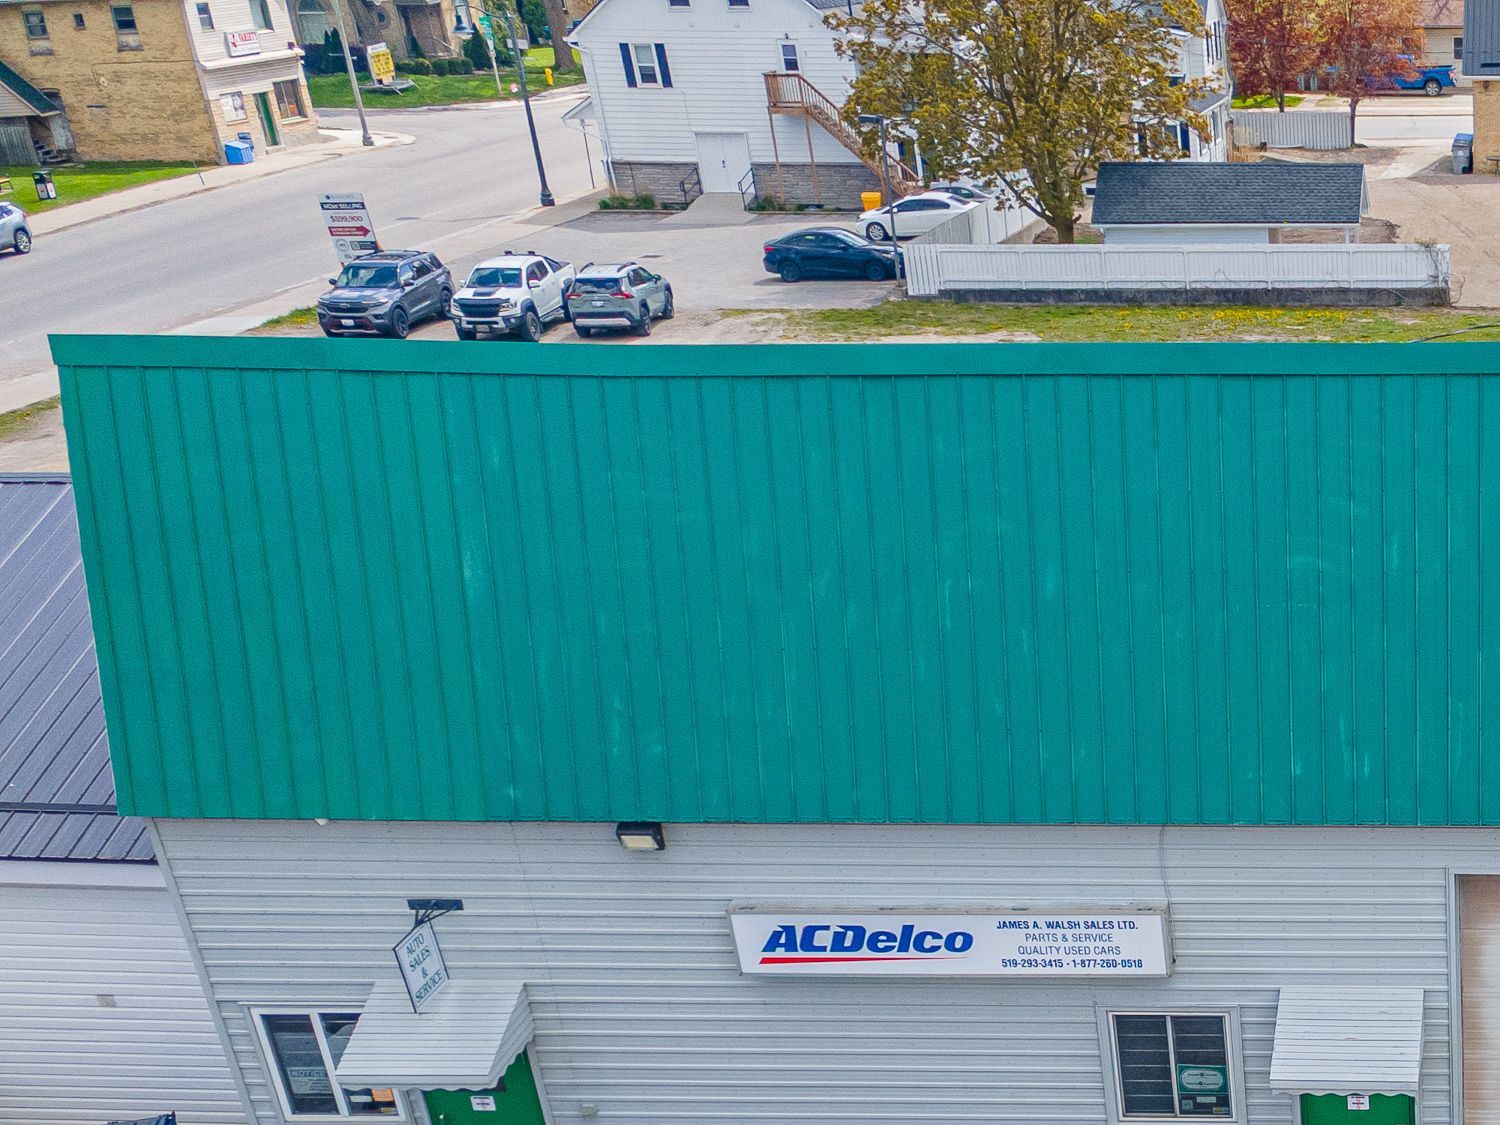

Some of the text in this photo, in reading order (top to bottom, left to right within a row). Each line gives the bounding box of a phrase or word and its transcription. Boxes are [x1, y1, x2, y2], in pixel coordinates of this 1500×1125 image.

[997, 920, 1139, 930] JAMES A. WALSH SALES LTD.
[761, 924, 974, 954] ACDelco
[1025, 932, 1113, 942] PARTS & SERVICE
[405, 932, 425, 956] AUTO
[1018, 945, 1121, 955] QUALITY USED CARS
[409, 945, 432, 972] SALES
[1001, 958, 1064, 968] 519-293-3415
[1072, 958, 1143, 968] 1-877-260-0518
[421, 966, 429, 979] &
[414, 968, 444, 1003] SERVICE
